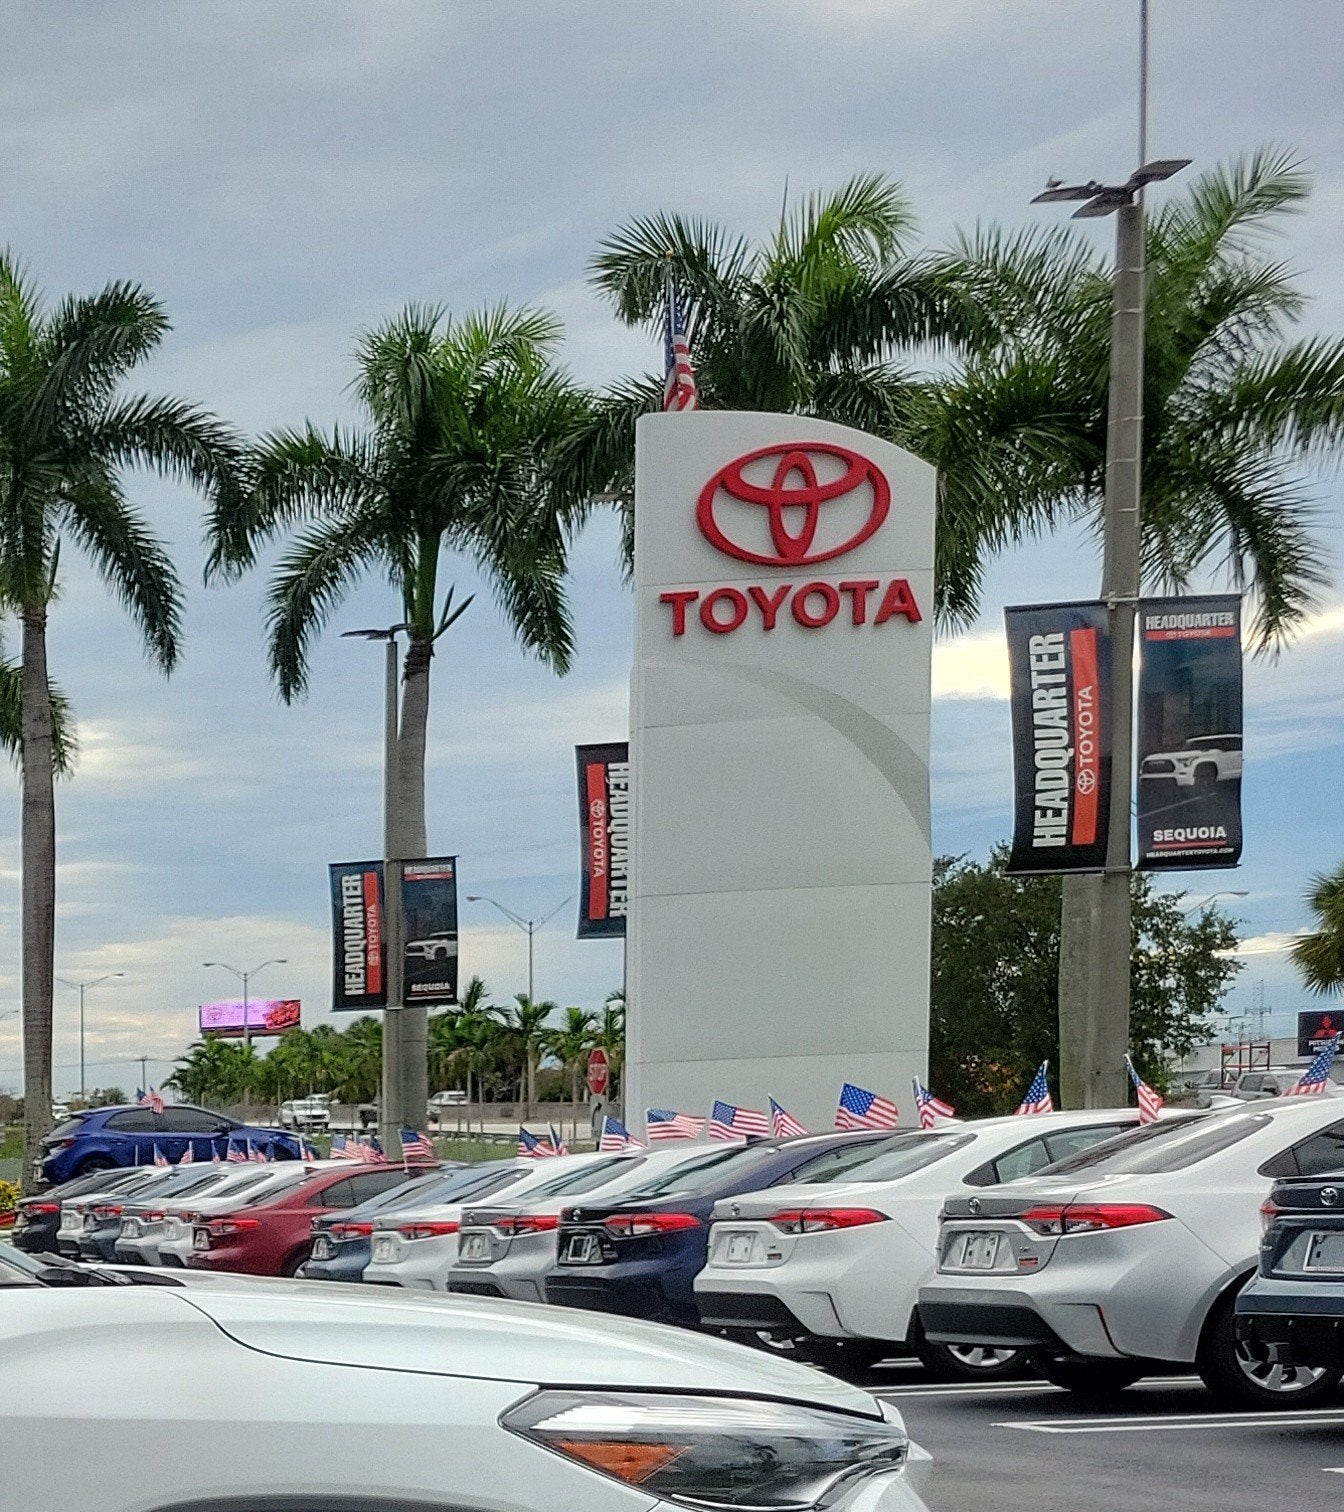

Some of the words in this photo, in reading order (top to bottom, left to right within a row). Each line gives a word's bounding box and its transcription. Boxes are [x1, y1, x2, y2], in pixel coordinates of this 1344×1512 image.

[659, 579, 923, 636] TOYOTA
[1146, 612, 1234, 630] HEADQUARTER
[1029, 632, 1073, 847] HEADQUARTER
[1077, 685, 1095, 767] TOYOTA
[592, 822, 605, 878] TOYOTA
[1153, 826, 1227, 841] SEQUOIA
[342, 874, 366, 995] HEADQUARTER
